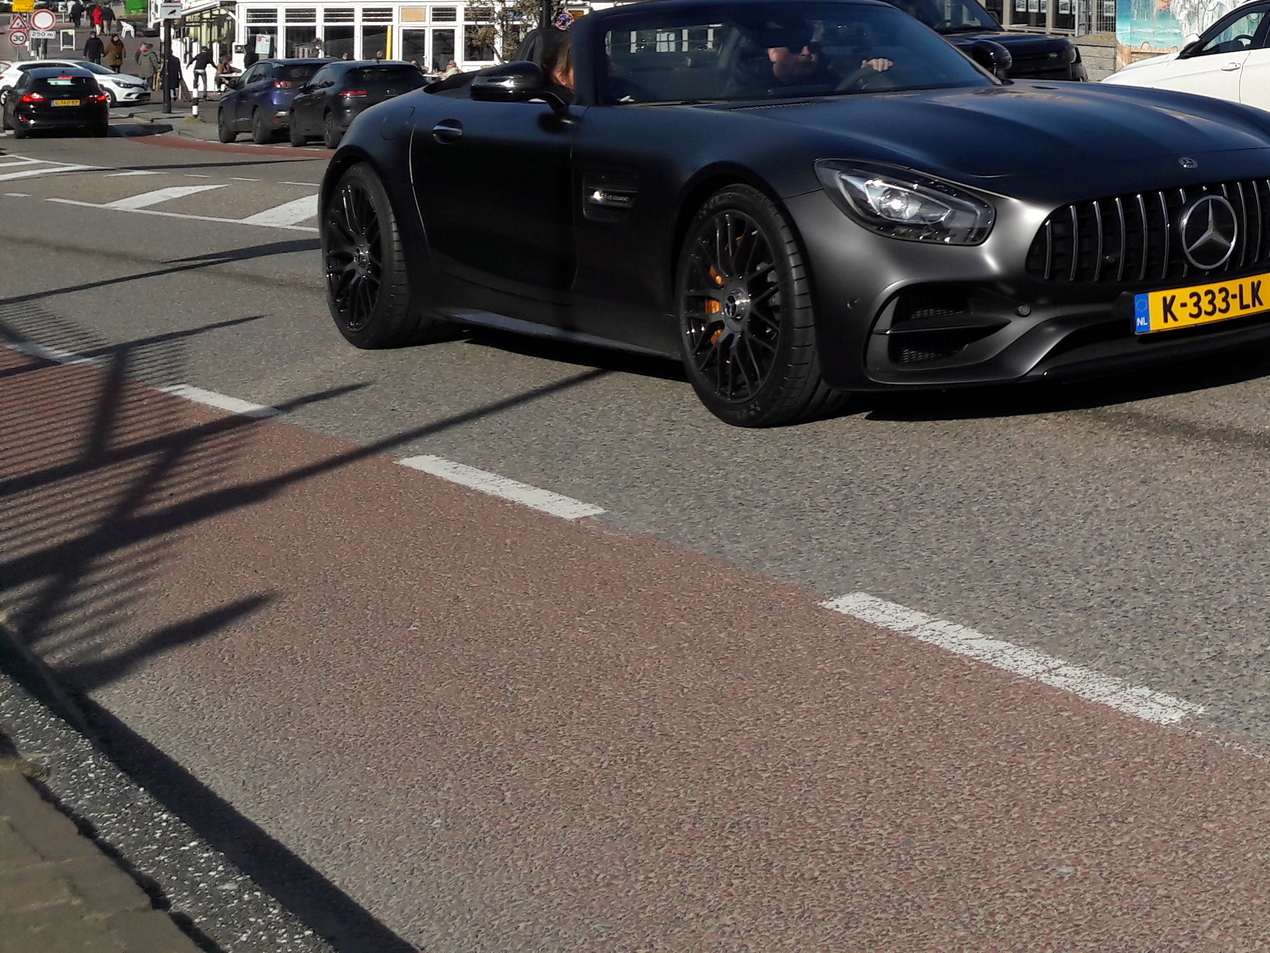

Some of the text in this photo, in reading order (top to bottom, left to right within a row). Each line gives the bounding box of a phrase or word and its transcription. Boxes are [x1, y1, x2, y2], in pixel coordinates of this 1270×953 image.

[13, 34, 25, 42] 30
[1162, 279, 1264, 324] K-333-LK
[1136, 317, 1149, 326] NL
